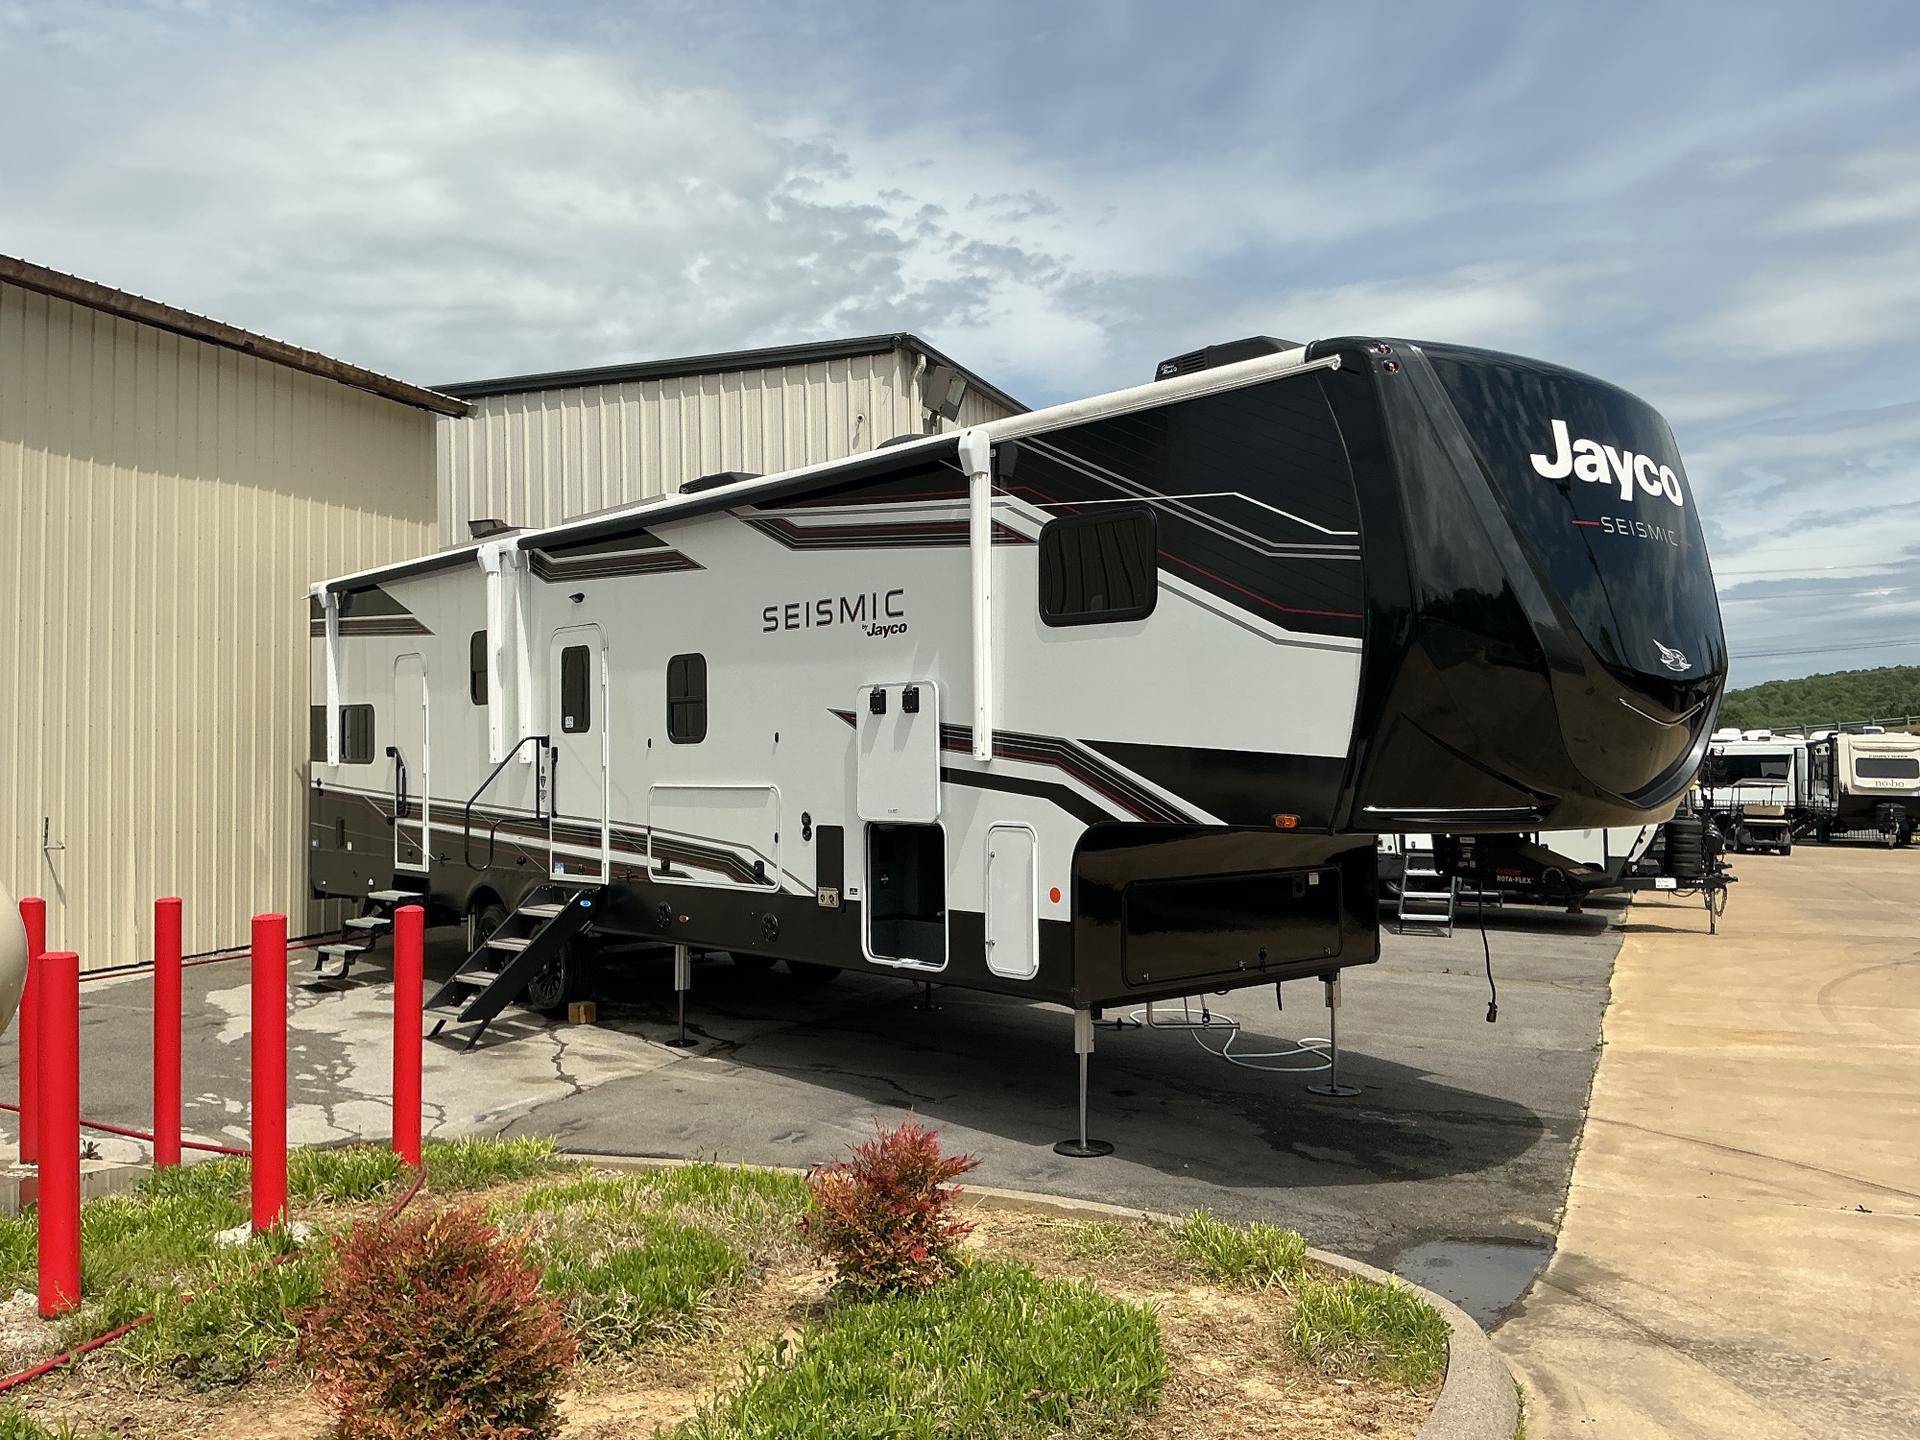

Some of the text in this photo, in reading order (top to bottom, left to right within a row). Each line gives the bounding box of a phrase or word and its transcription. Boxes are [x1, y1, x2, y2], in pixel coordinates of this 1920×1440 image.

[1530, 419, 1683, 507] Jayco
[1600, 516, 1679, 547] SEISMIC
[762, 588, 904, 633] SEISMIC
[866, 623, 907, 638] Jayco
[1497, 875, 1531, 884] ROTA-FLEX
